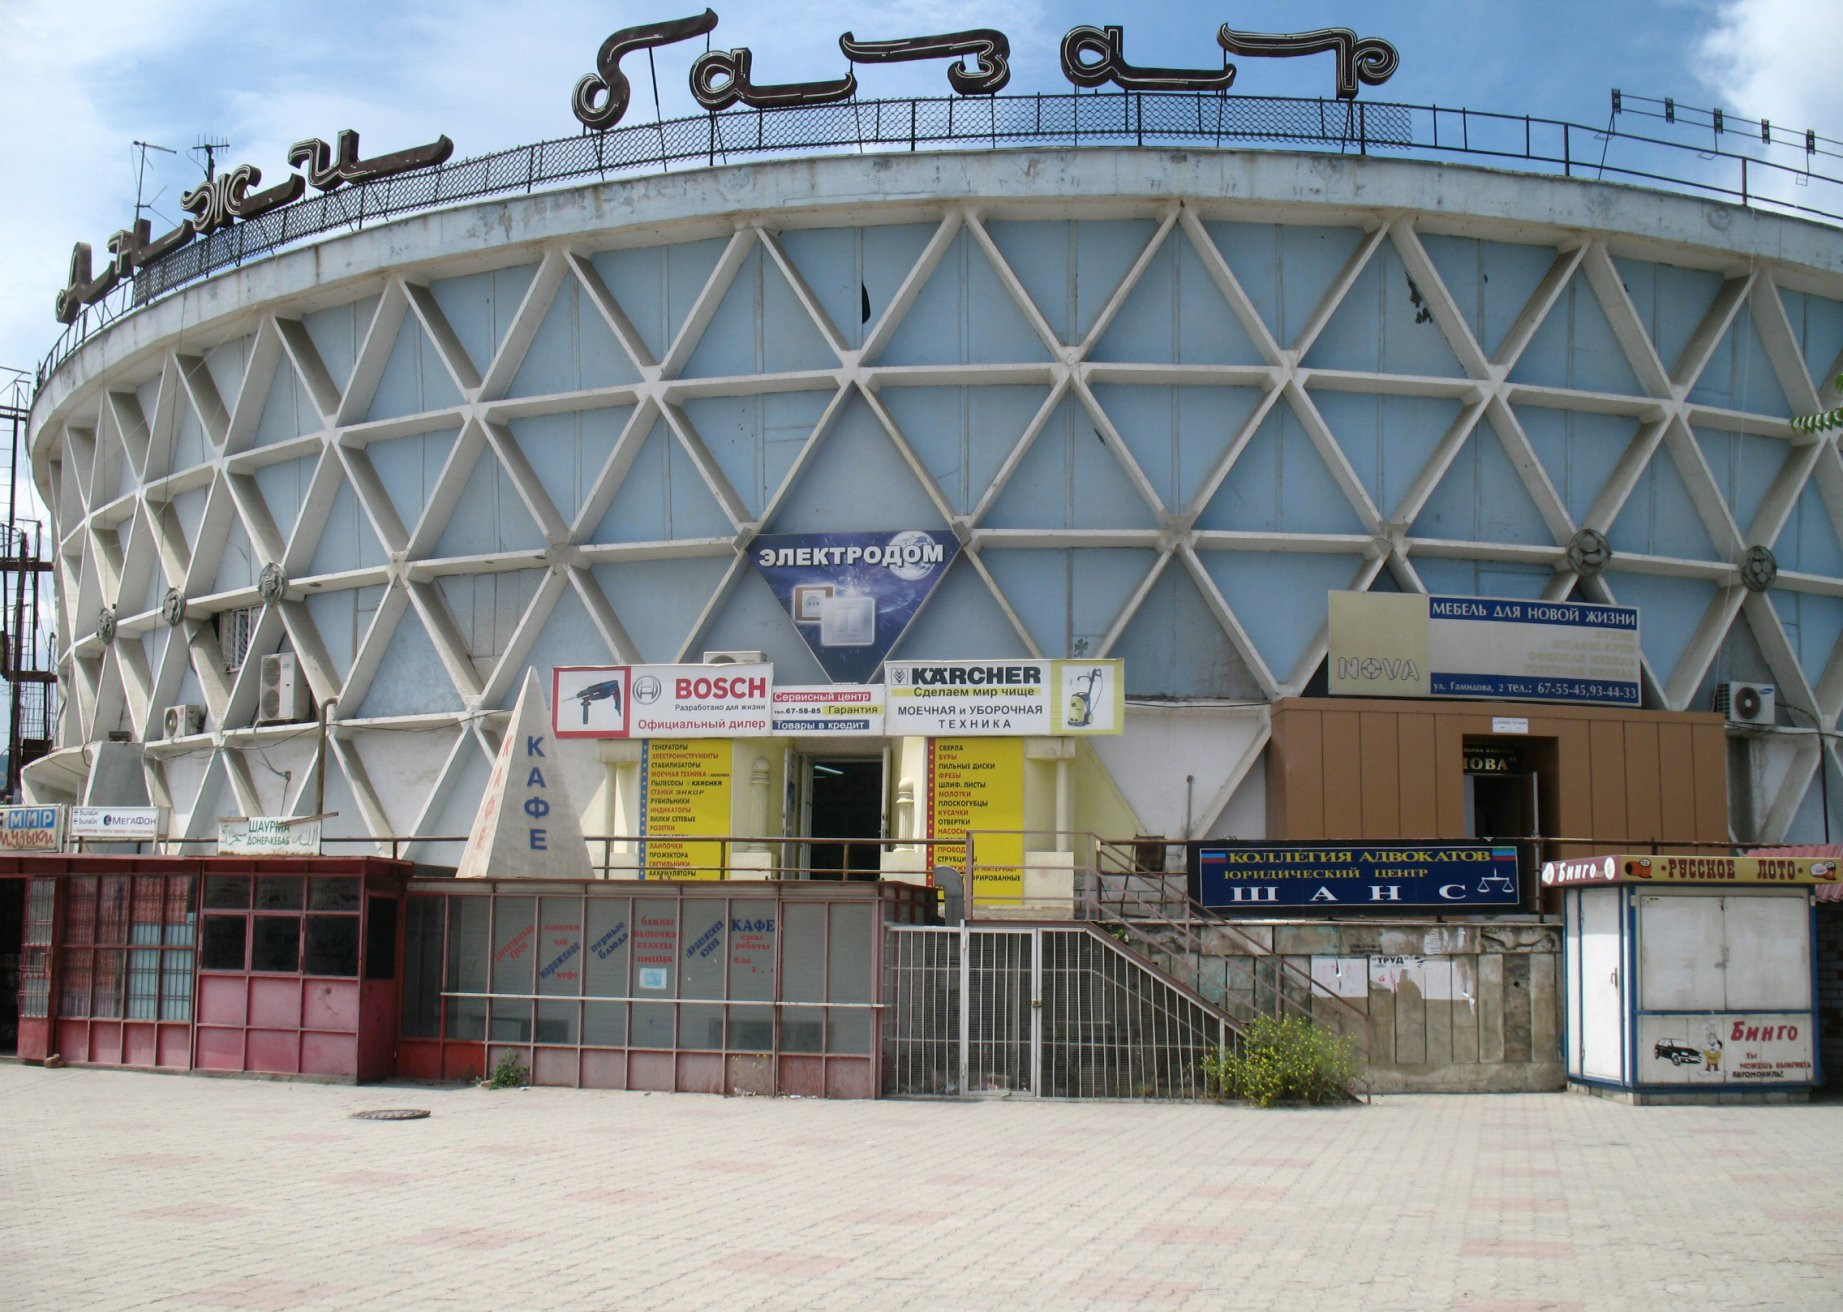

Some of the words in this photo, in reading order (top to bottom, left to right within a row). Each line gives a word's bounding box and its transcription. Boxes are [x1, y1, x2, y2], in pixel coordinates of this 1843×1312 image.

[759, 544, 944, 567] ЭЛЕКТРОДОМ
[1432, 603, 1487, 616] МЕБЕЛЬ
[1493, 606, 1521, 618] ДЛЯ
[1528, 606, 1580, 622] НОВОЙ
[1585, 610, 1636, 626] ЖИЗНИ
[1338, 656, 1420, 681] NOVA
[911, 666, 1042, 686] KÄRCHER
[675, 677, 766, 700] BOSCH
[914, 687, 969, 698] Сделаем
[973, 688, 998, 698] мир
[1001, 687, 1035, 697] чище
[1433, 682, 1446, 692] ул.
[1450, 681, 1494, 693] Гамидова,
[1508, 683, 1532, 694] тел.:
[1537, 684, 1637, 698] 67-55-45,93-44-33
[774, 691, 834, 702] Сервисный
[838, 692, 870, 702] центр
[675, 704, 724, 712] Разработано
[828, 705, 878, 715] Гарантия
[898, 706, 956, 716] МОЕЧНАЯ
[959, 707, 966, 715] и
[969, 705, 1043, 715] УБОРОЧНАЯ
[638, 719, 726, 731] Официальный
[728, 719, 766, 731] дилер
[776, 721, 815, 731] Товары
[828, 721, 865, 731] кредит
[939, 719, 1012, 729] ТЕХНИКА
[524, 735, 550, 850] КАФЕ
[10, 811, 54, 828] МИР
[247, 836, 290, 846] ДОНЕР-КЕБАБ
[1229, 851, 1352, 864] КОЛЛЕГИЯ
[1359, 850, 1491, 863] АДВОКАТОВ
[1224, 867, 1361, 880] ЮРИДИЧЕСКИЙ
[1374, 867, 1428, 878] ЦЕНТР
[1668, 859, 1736, 880] РУССКОЕ
[1757, 860, 1796, 880] ЛОТО
[1230, 884, 1467, 902] ШАНС
[731, 919, 775, 932] КАФЕ
[597, 932, 629, 961] блюда
